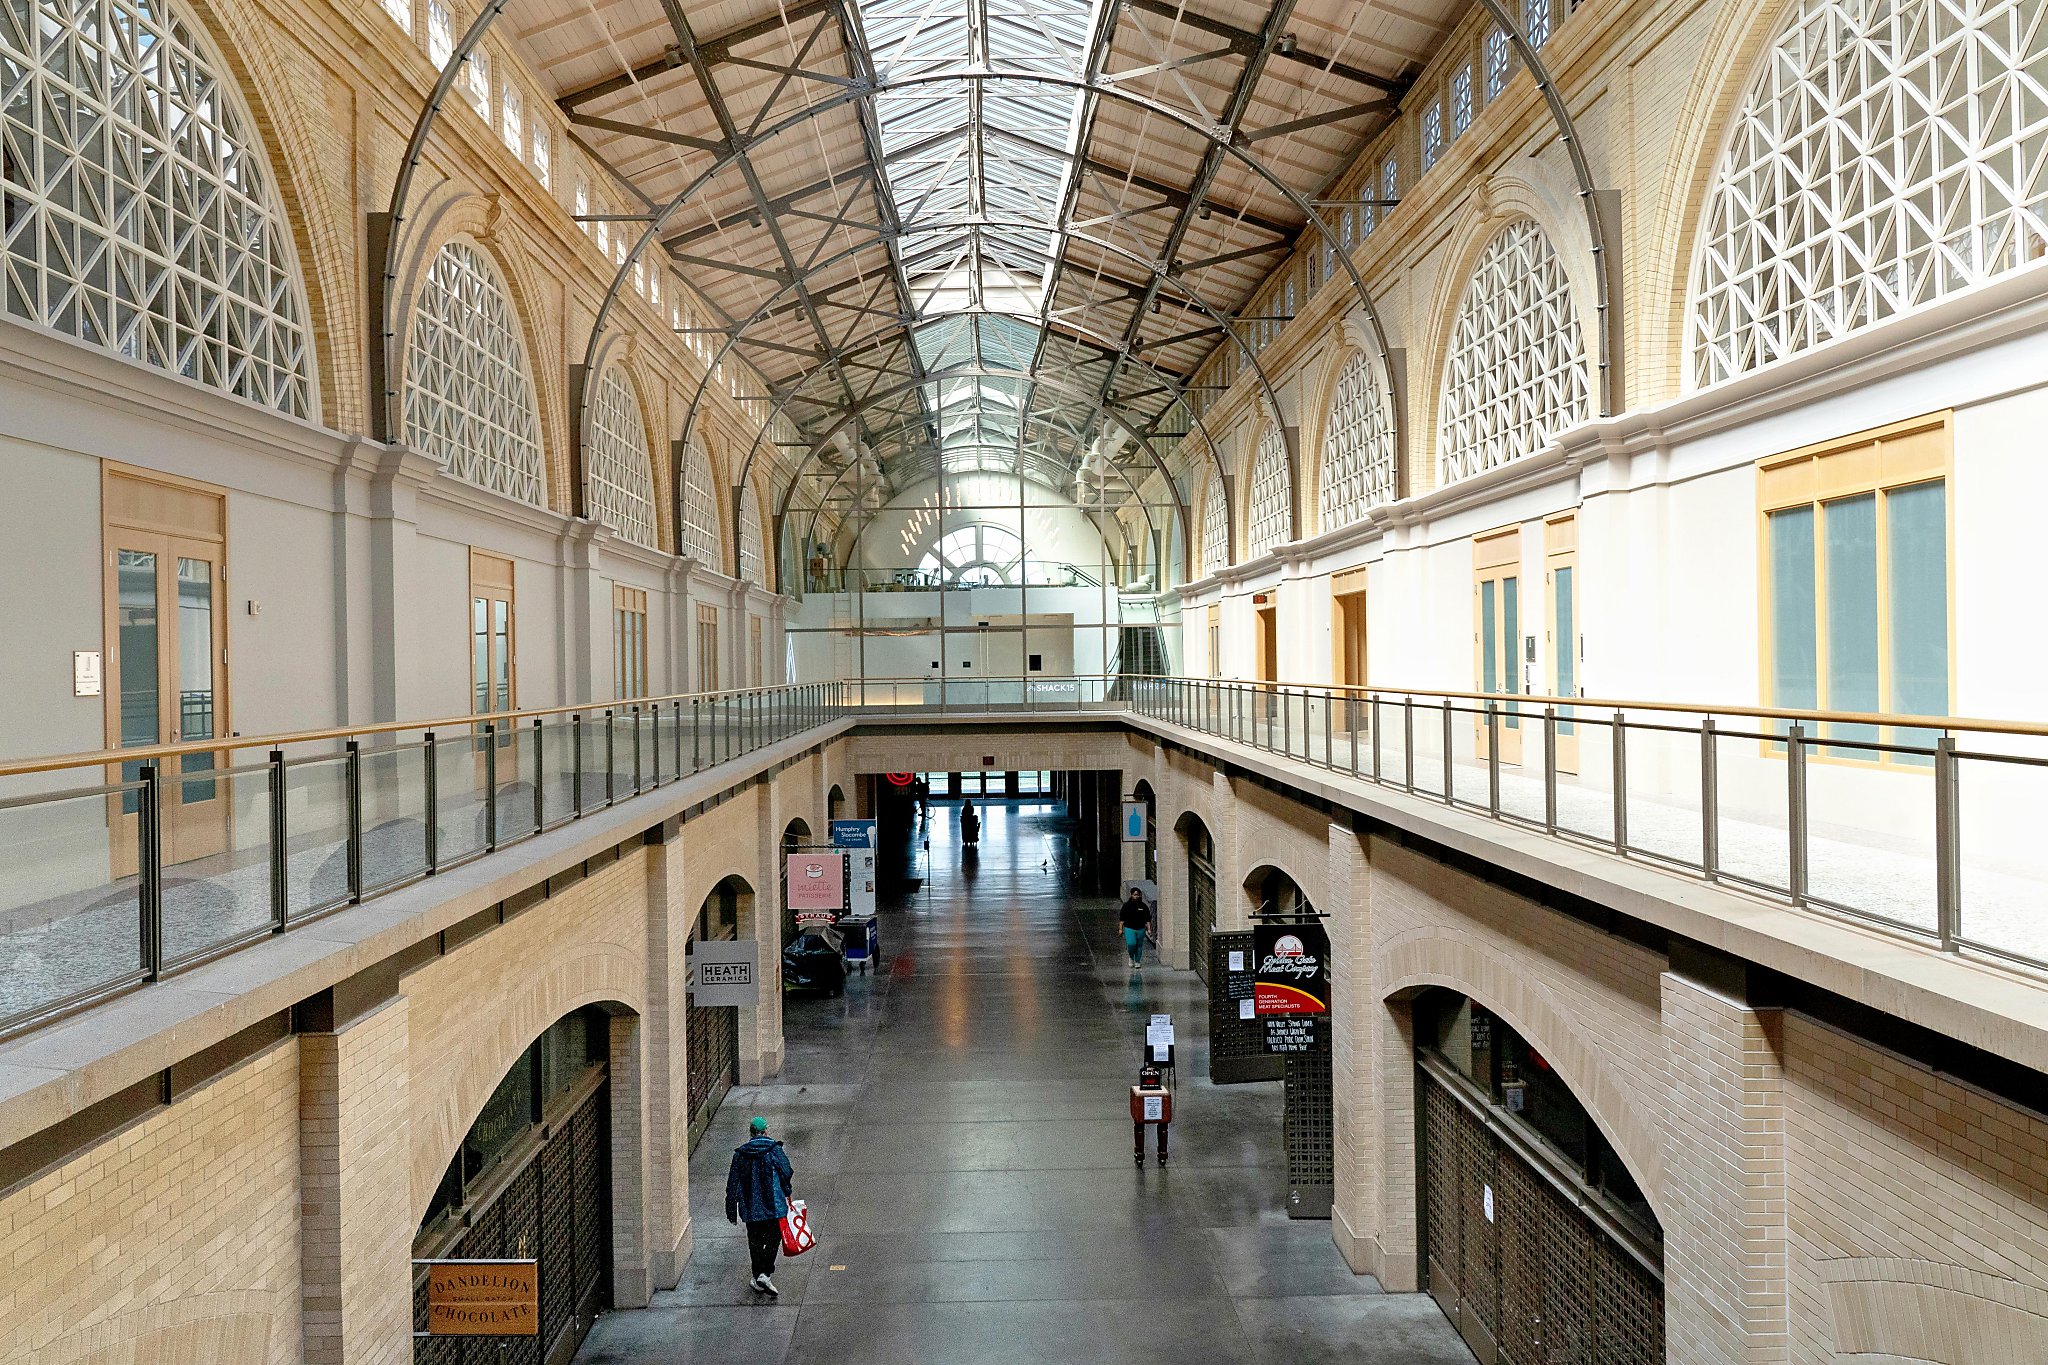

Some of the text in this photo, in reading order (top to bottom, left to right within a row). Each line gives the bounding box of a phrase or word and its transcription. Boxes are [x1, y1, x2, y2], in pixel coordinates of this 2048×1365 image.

[1036, 684, 1075, 692] SHACK15
[797, 880, 833, 891] miette
[1263, 952, 1293, 965] Golden
[704, 966, 748, 975] HEATH
[1258, 963, 1318, 980] Meat Company
[434, 1275, 531, 1294] DANDELION
[434, 1303, 531, 1323] CHOCOLATE
